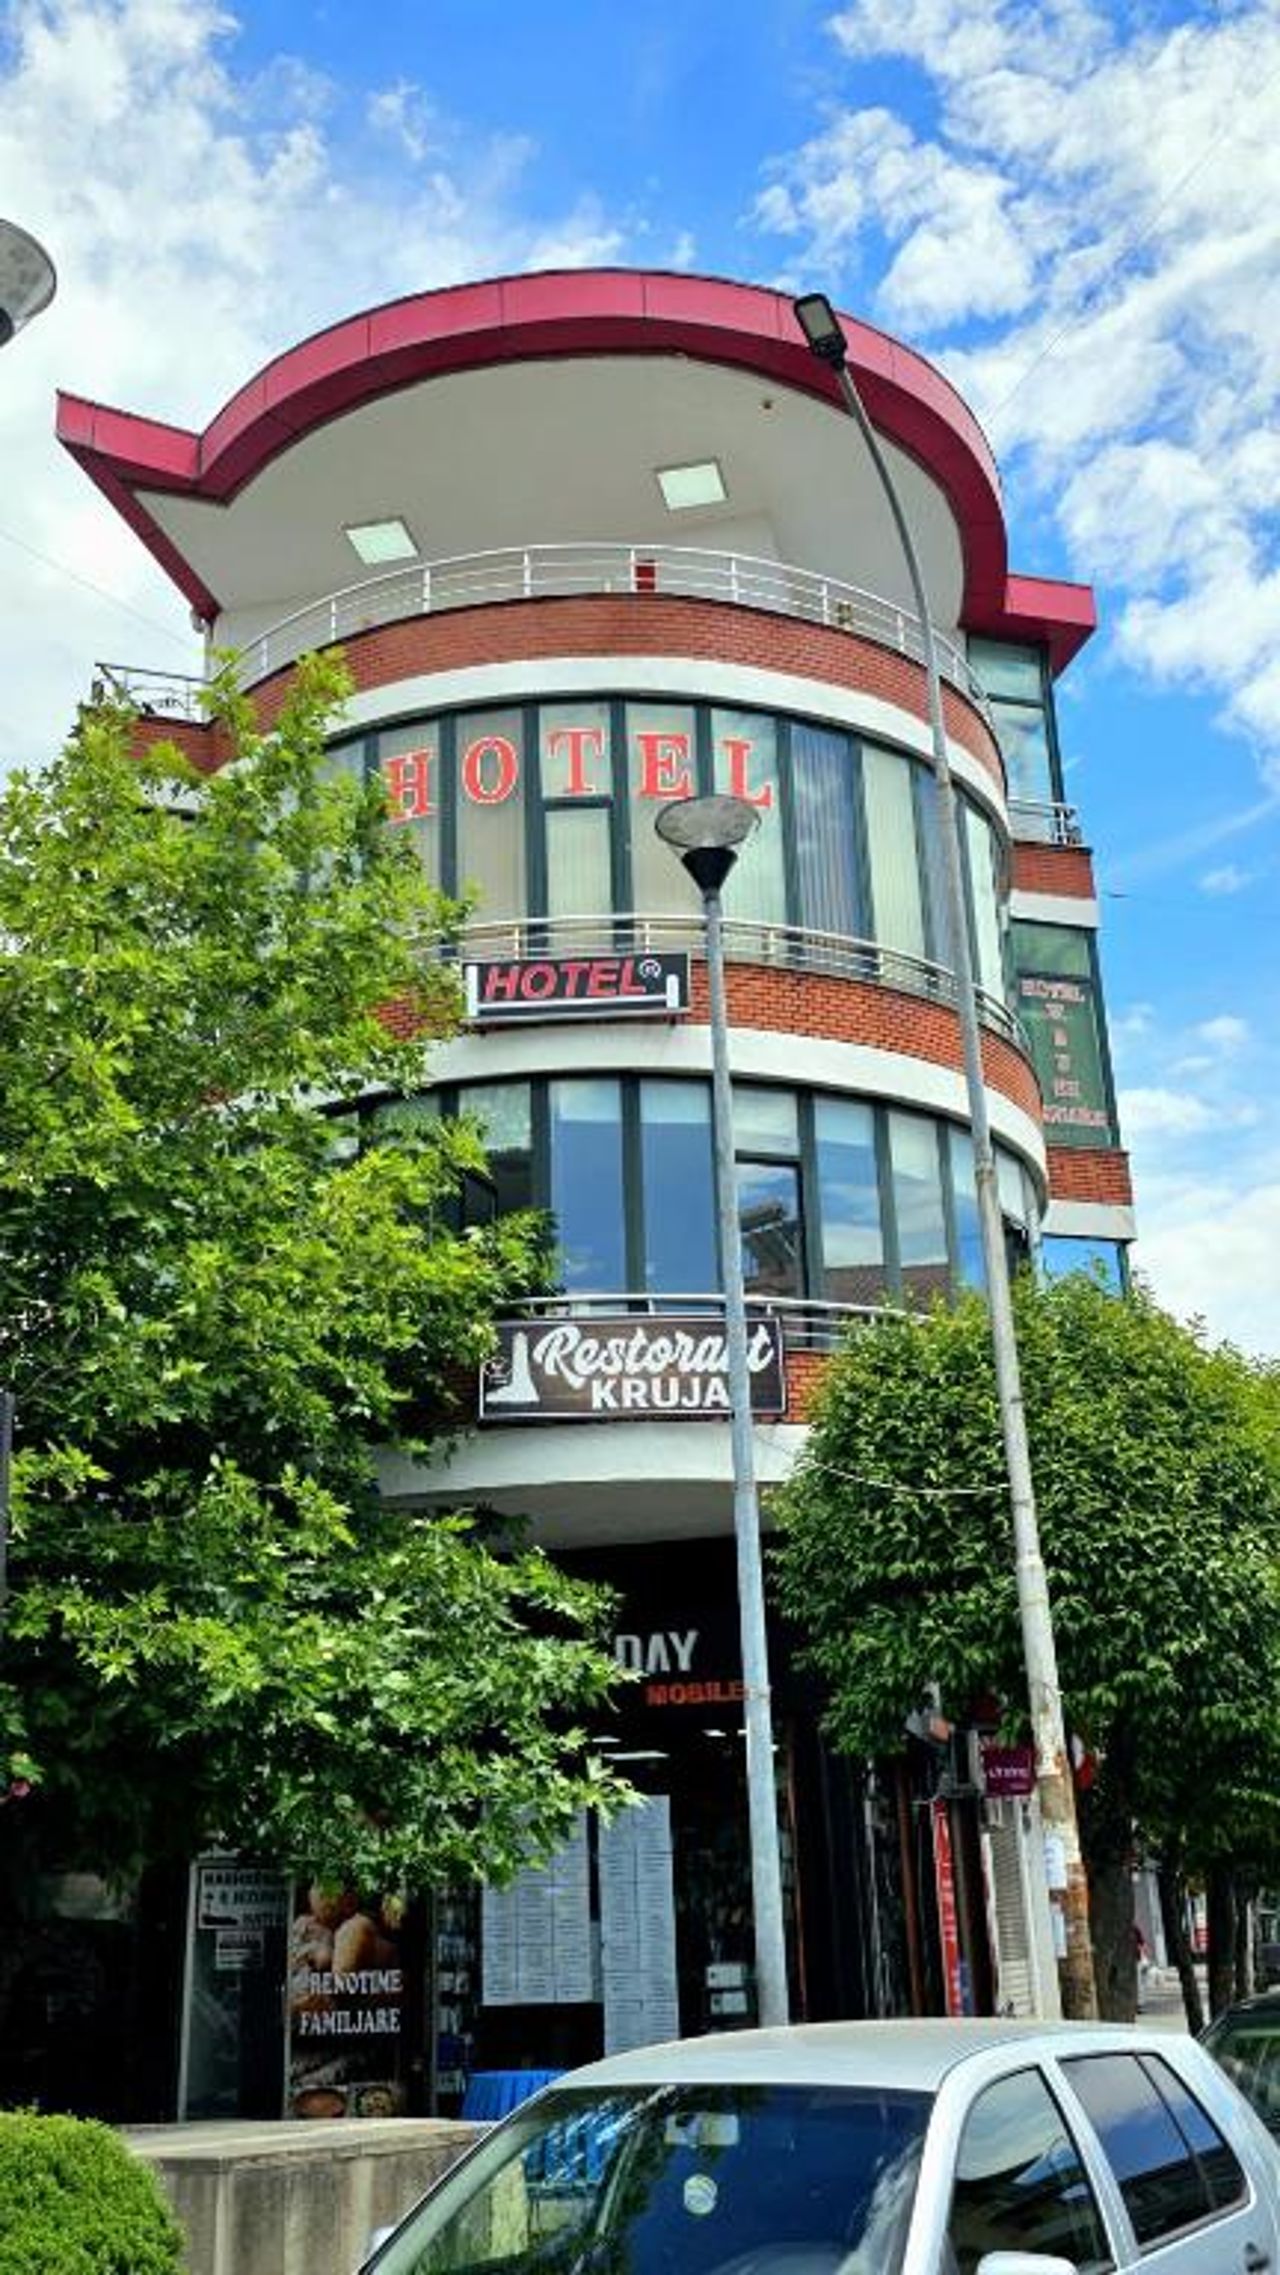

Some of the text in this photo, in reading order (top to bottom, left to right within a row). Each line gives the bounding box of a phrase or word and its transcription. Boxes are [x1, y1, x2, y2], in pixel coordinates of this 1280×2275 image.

[385, 727, 772, 822] HOTEL
[484, 957, 646, 1000] HOTEL
[532, 1323, 774, 1390] Restorat
[591, 1375, 731, 1409] KRUJA
[615, 1628, 699, 1673] DAY
[299, 2007, 401, 2036] FAMILJARE
